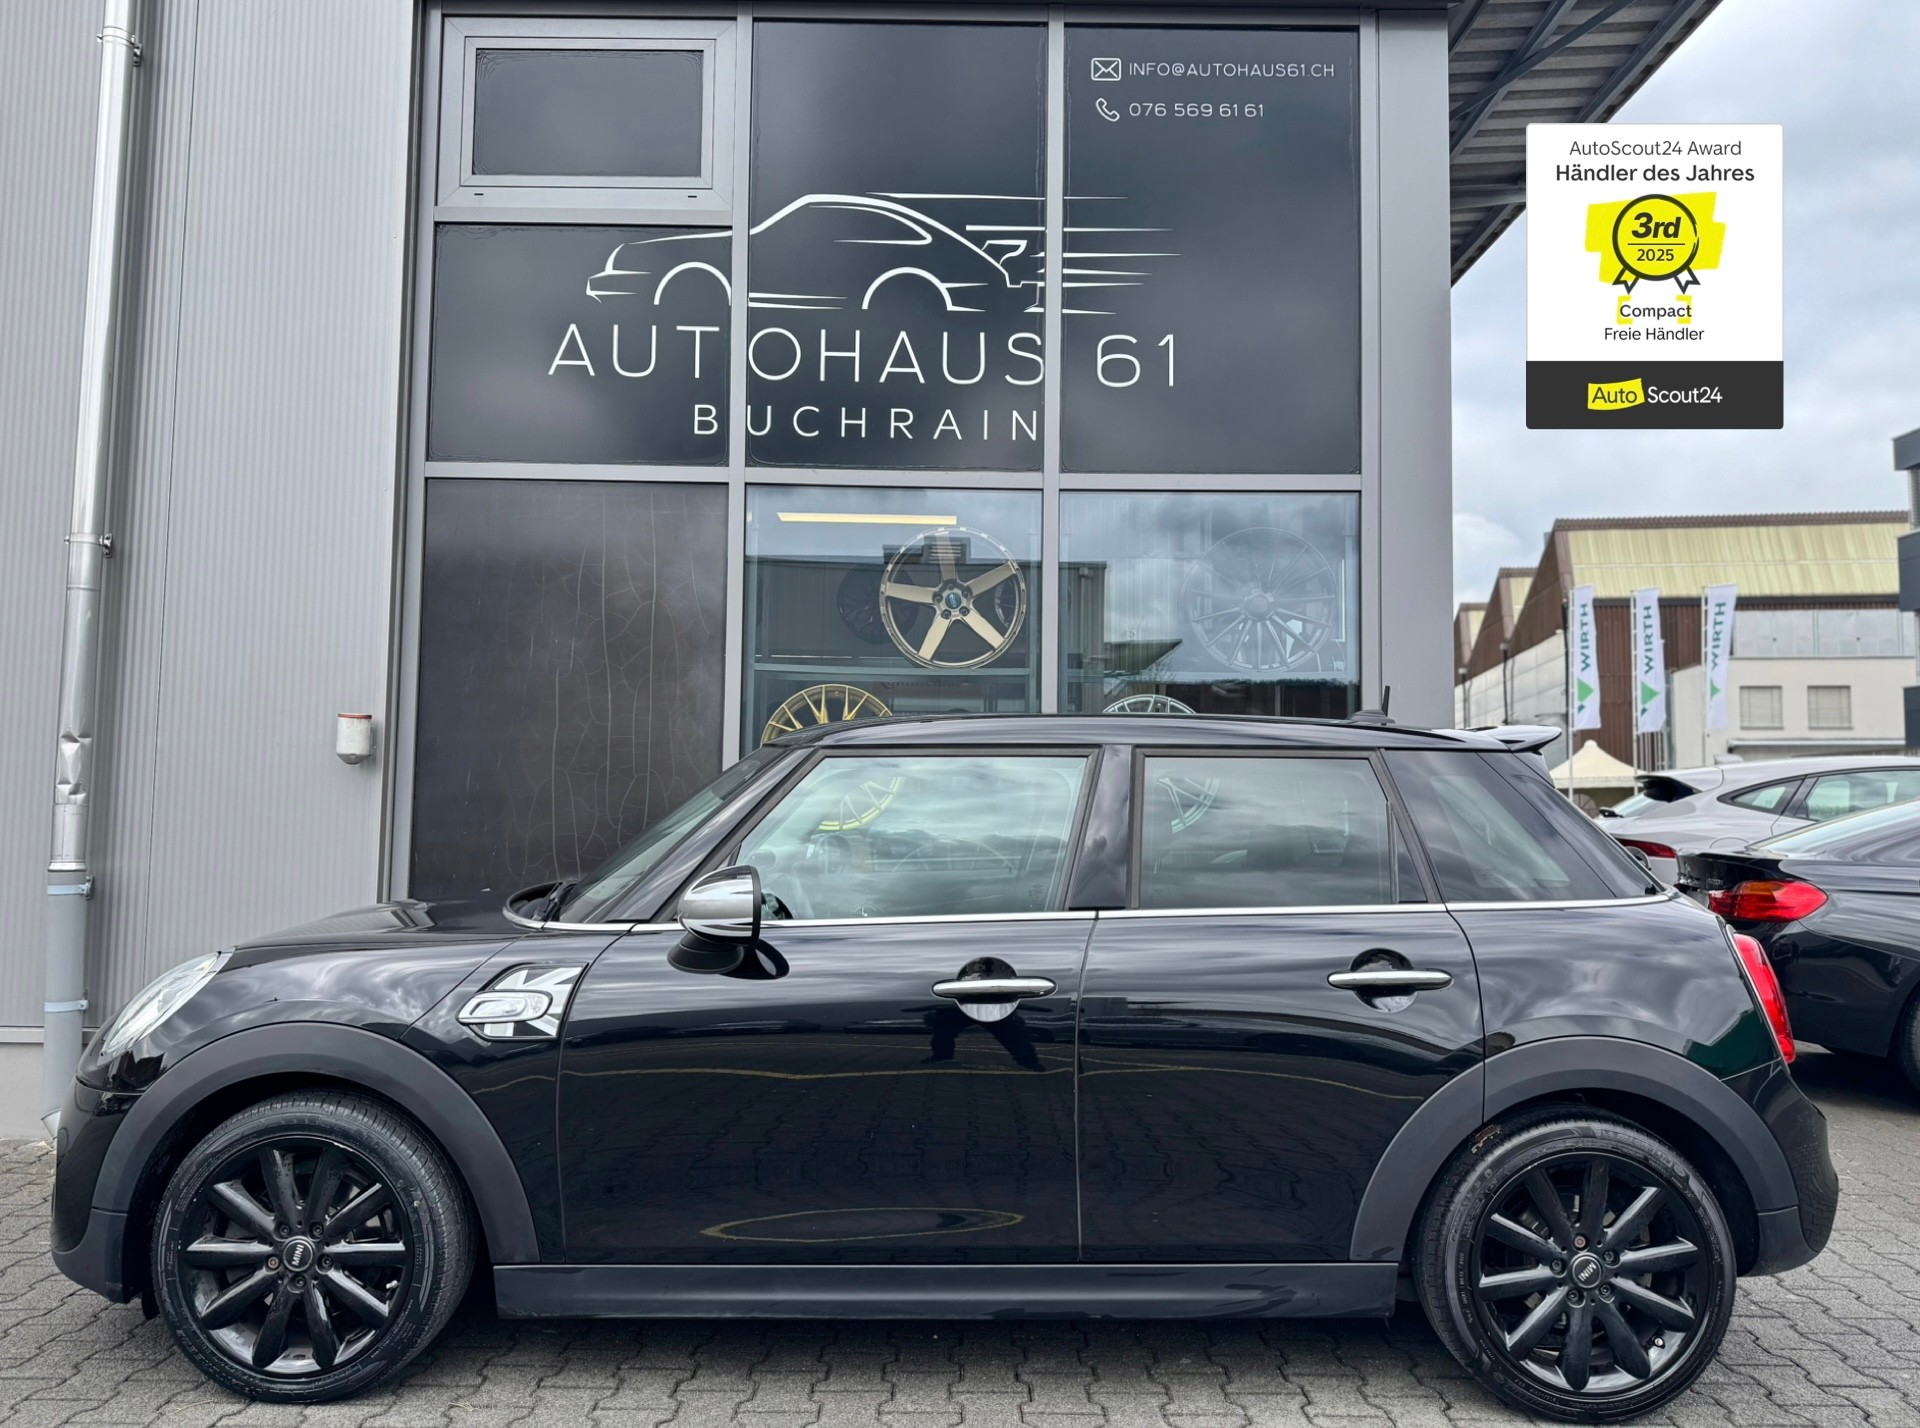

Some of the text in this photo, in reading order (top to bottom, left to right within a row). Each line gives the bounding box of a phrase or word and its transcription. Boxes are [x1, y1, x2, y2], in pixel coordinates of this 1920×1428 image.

[1129, 62, 1335, 77] INFO@AUTOHAUS61.CH
[1129, 102, 1264, 118] 076 569 61 61
[548, 324, 1174, 388] AUTOHAUS 61
[694, 404, 1037, 441] BUCHRAIN
[1580, 603, 1591, 672] WIRTH
[1643, 606, 1654, 675] WIRTH
[1711, 602, 1727, 671] WIRTH
[291, 1244, 305, 1266] MINI
[1578, 1261, 1598, 1282] MINI
